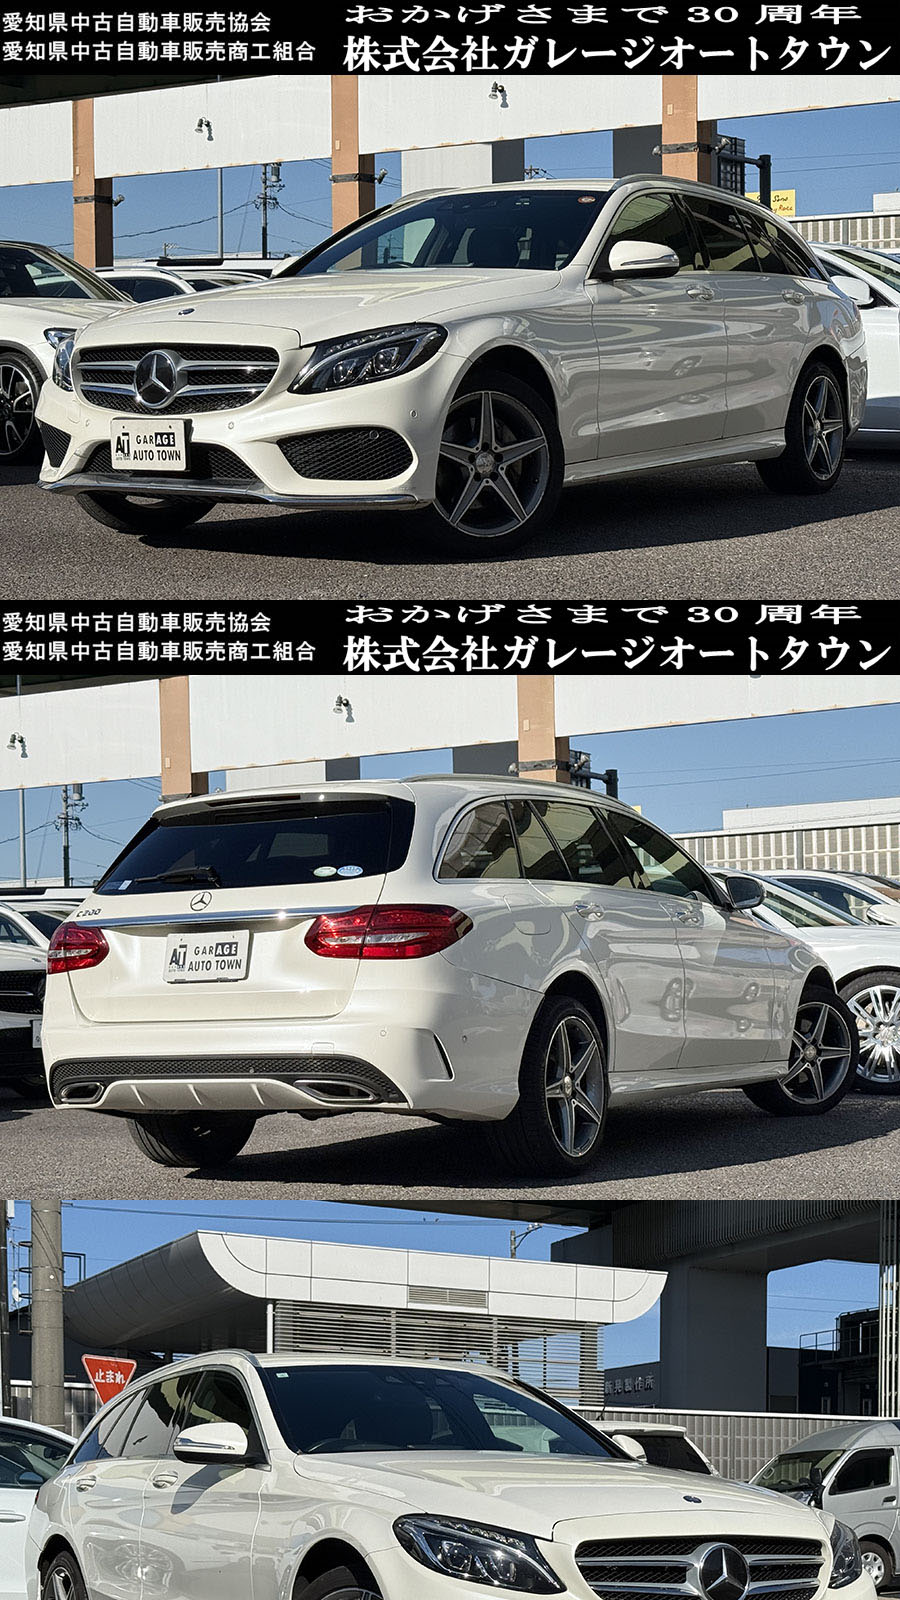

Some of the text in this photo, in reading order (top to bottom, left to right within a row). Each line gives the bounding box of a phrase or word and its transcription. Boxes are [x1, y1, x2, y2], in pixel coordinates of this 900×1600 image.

[136, 433, 175, 446] GARAGE
[133, 450, 154, 461] AUTO
[156, 450, 181, 461] TOWN
[194, 943, 237, 956] GARAGE
[188, 960, 212, 971] AUTO
[215, 959, 242, 970] TOWN
[94, 1368, 126, 1385] 止まれ
